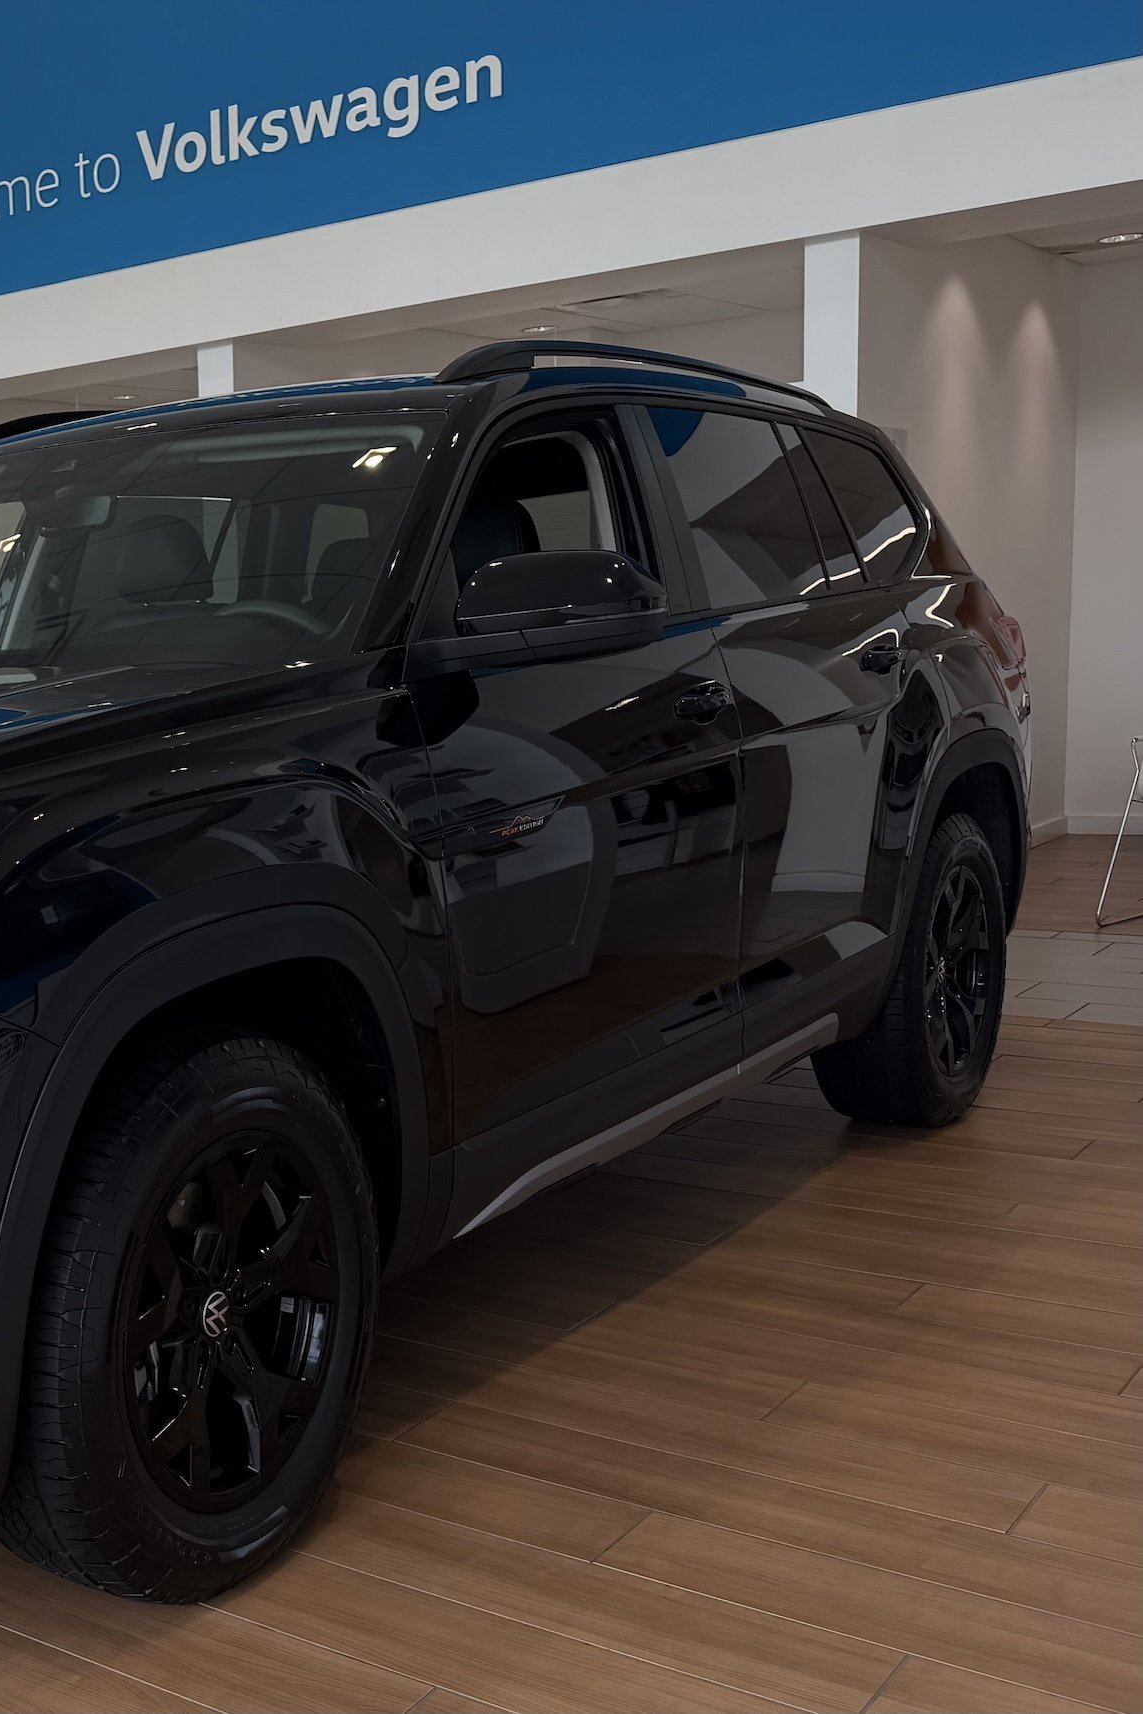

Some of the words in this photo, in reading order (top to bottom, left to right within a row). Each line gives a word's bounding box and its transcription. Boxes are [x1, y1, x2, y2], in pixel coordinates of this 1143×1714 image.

[74, 152, 121, 199] to
[135, 54, 503, 181] Volkswagen
[501, 826, 519, 837] PEAK
